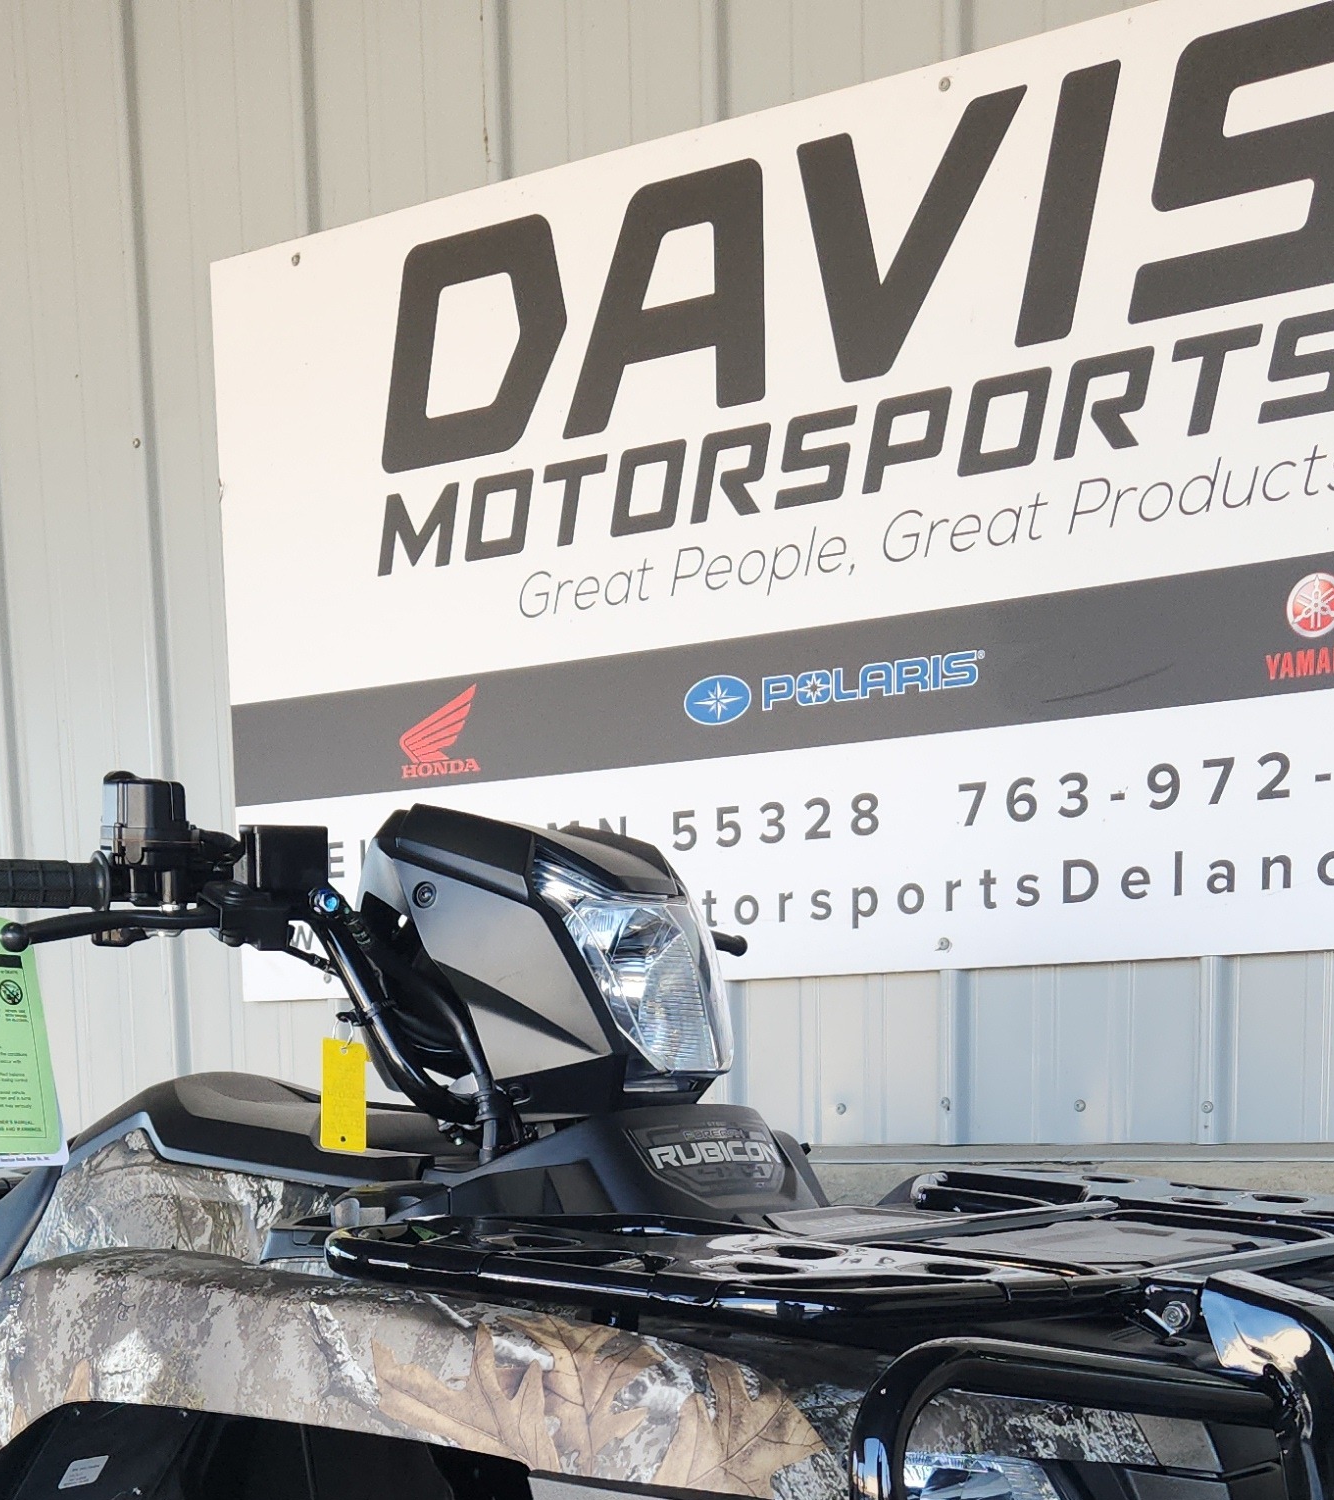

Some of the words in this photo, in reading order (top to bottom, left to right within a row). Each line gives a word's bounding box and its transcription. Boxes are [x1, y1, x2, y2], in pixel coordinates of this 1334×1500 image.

[519, 557, 654, 620] Great
[670, 525, 856, 597] People,
[883, 491, 1048, 563] Great
[762, 650, 980, 711] POLARIS
[401, 758, 481, 779] HONDA
[672, 793, 879, 852] 55328
[648, 1140, 782, 1170] RUBICON
